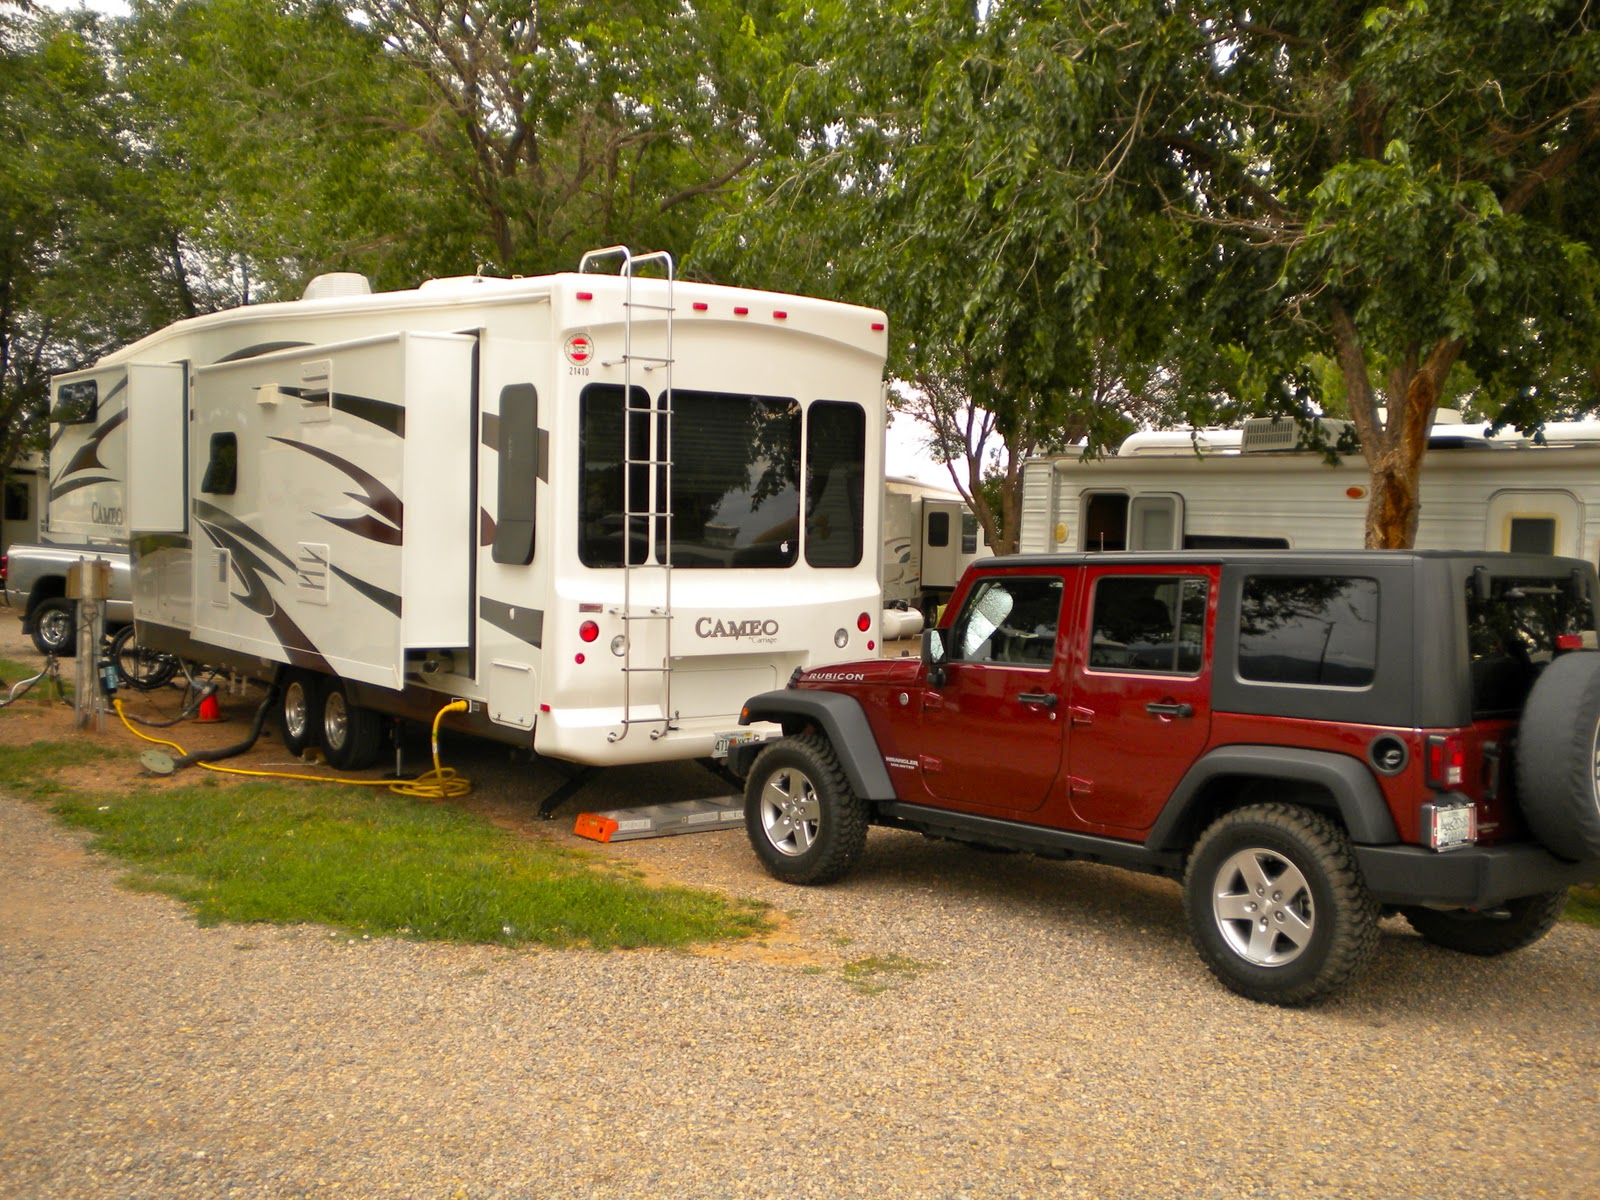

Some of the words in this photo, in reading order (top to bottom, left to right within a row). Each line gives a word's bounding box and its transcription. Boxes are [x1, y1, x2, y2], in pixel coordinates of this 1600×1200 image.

[569, 366, 589, 376] 21410
[92, 502, 123, 525] CAMEO
[695, 617, 779, 640] CAMEO
[808, 673, 864, 681] RUBICON
[885, 756, 919, 767] WRANGLER
